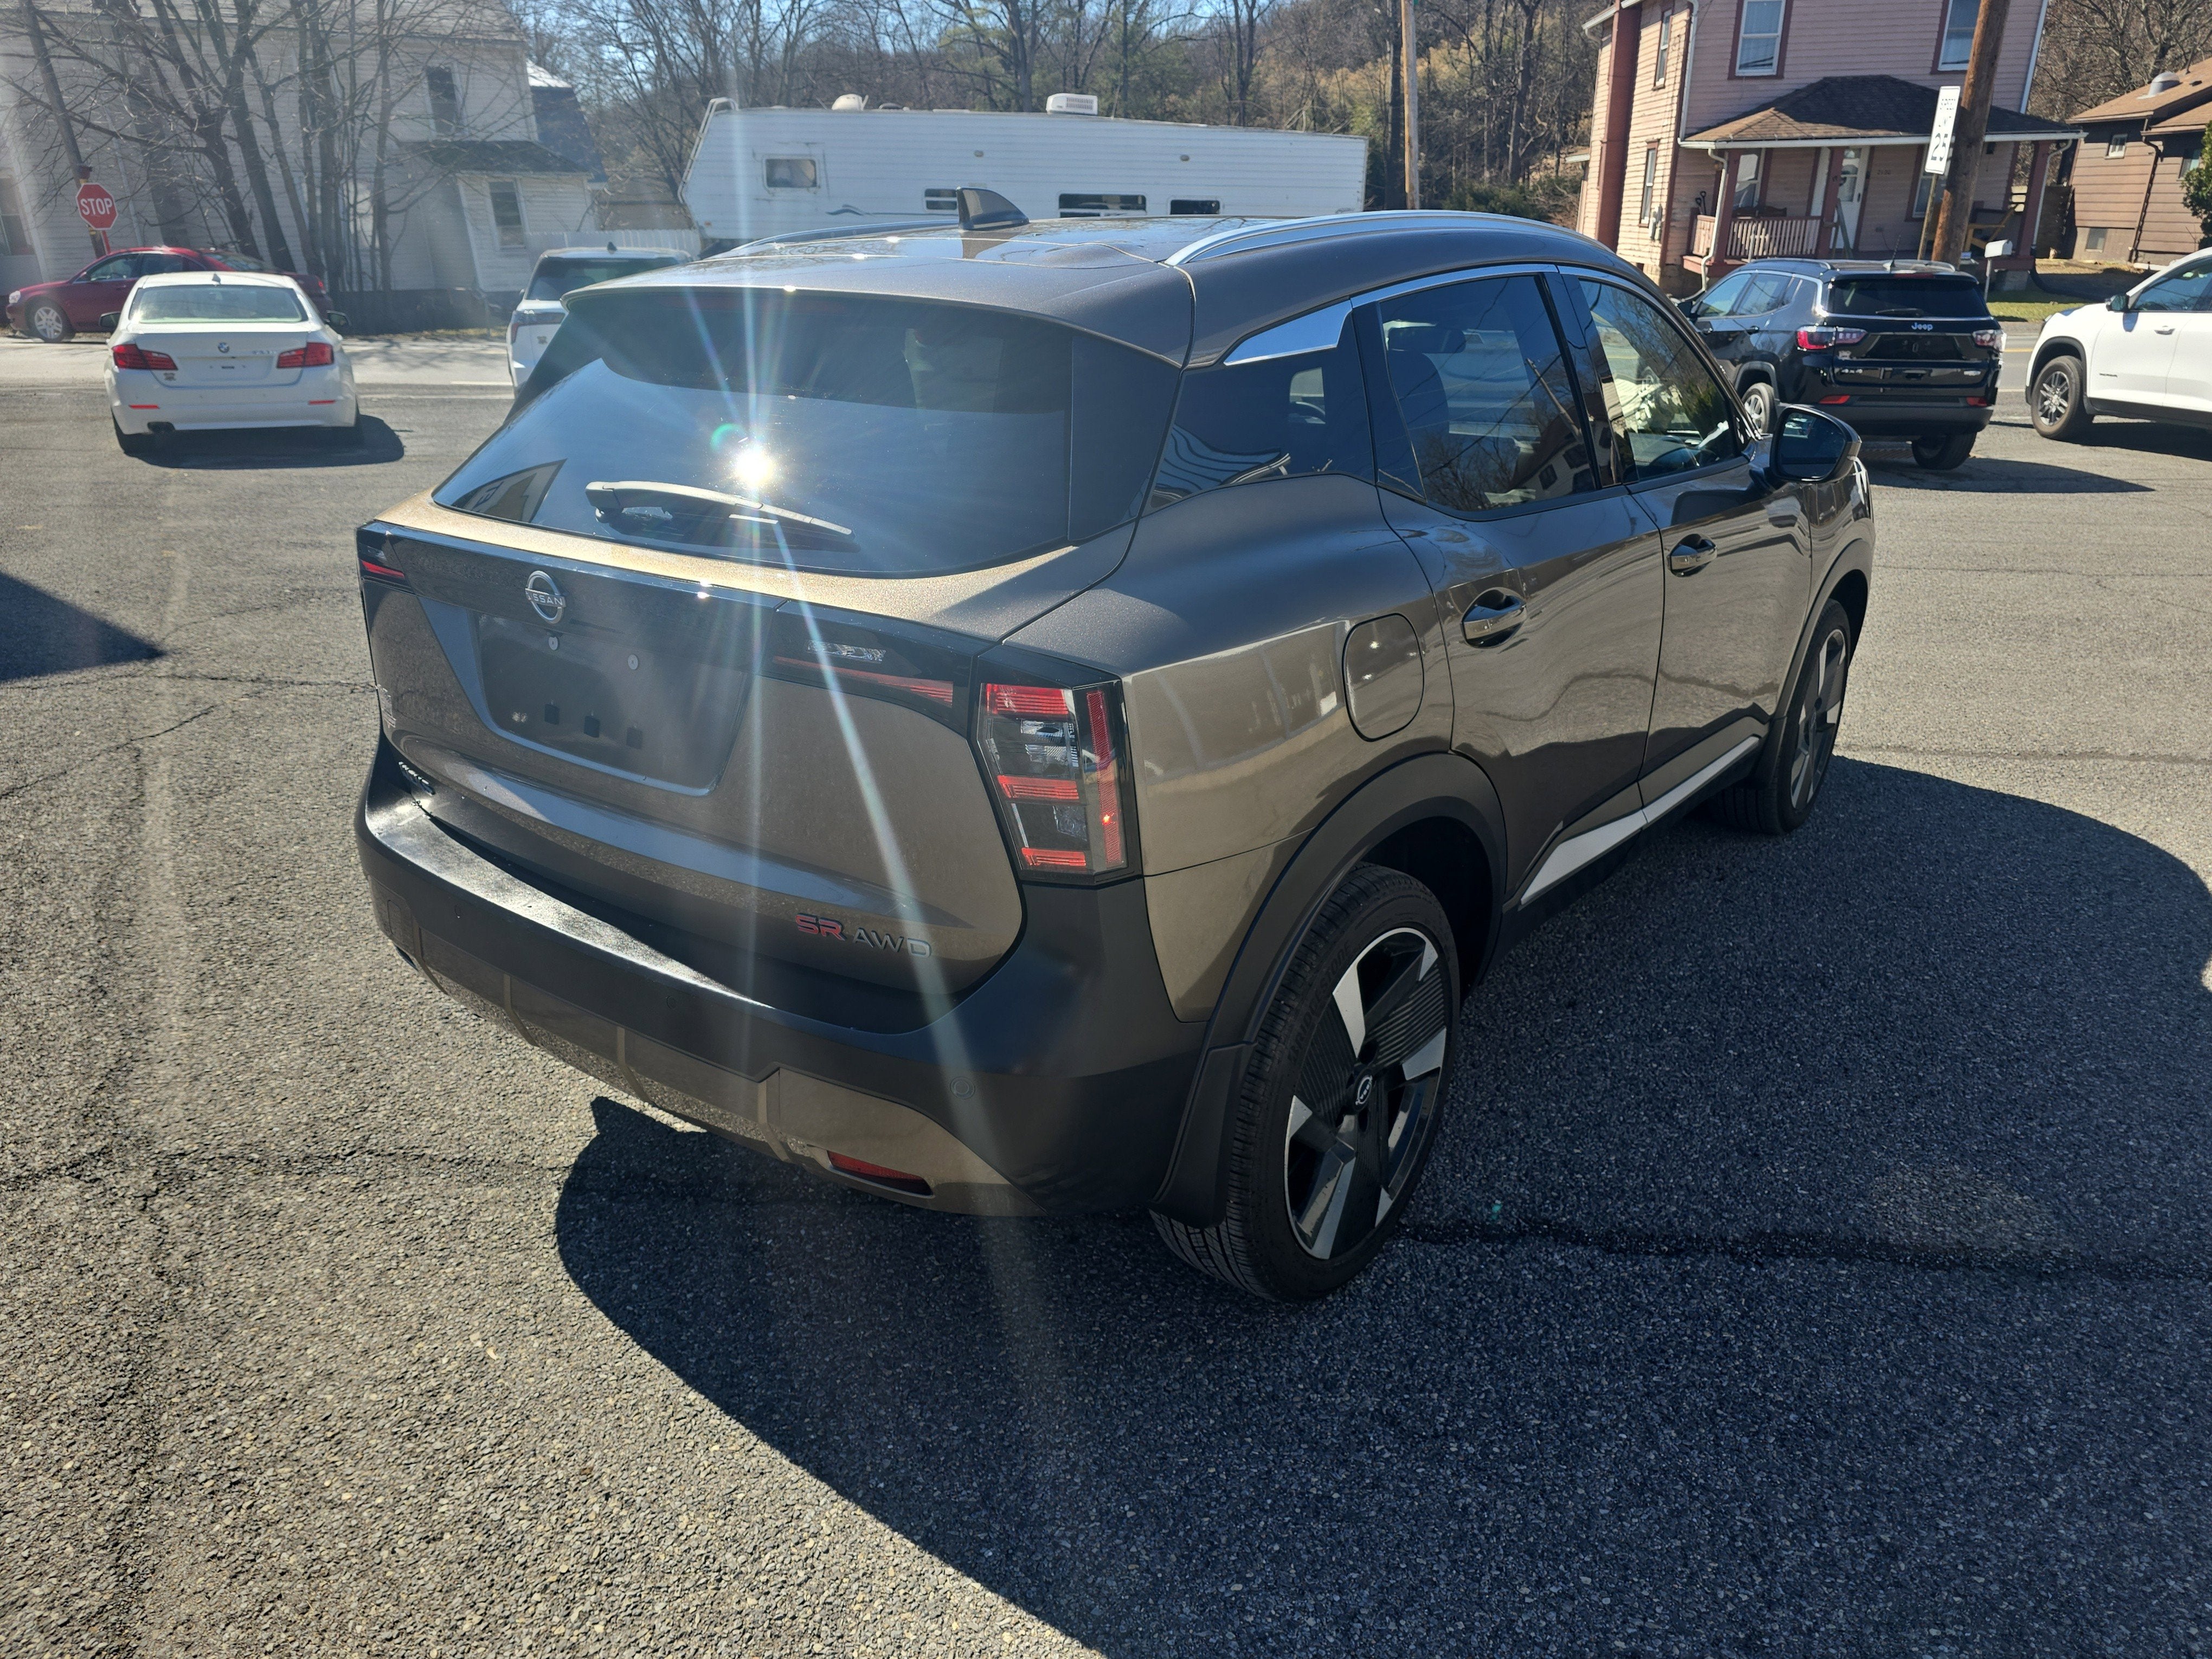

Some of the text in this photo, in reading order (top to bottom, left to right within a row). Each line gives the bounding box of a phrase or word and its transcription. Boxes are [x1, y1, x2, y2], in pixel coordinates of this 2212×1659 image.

[1931, 133, 1949, 162] 25
[80, 198, 113, 215] STOP
[1911, 322, 1933, 331] Jeep
[795, 913, 932, 959] SR AWD
[1287, 939, 1353, 1064] BRIDGESTONE
